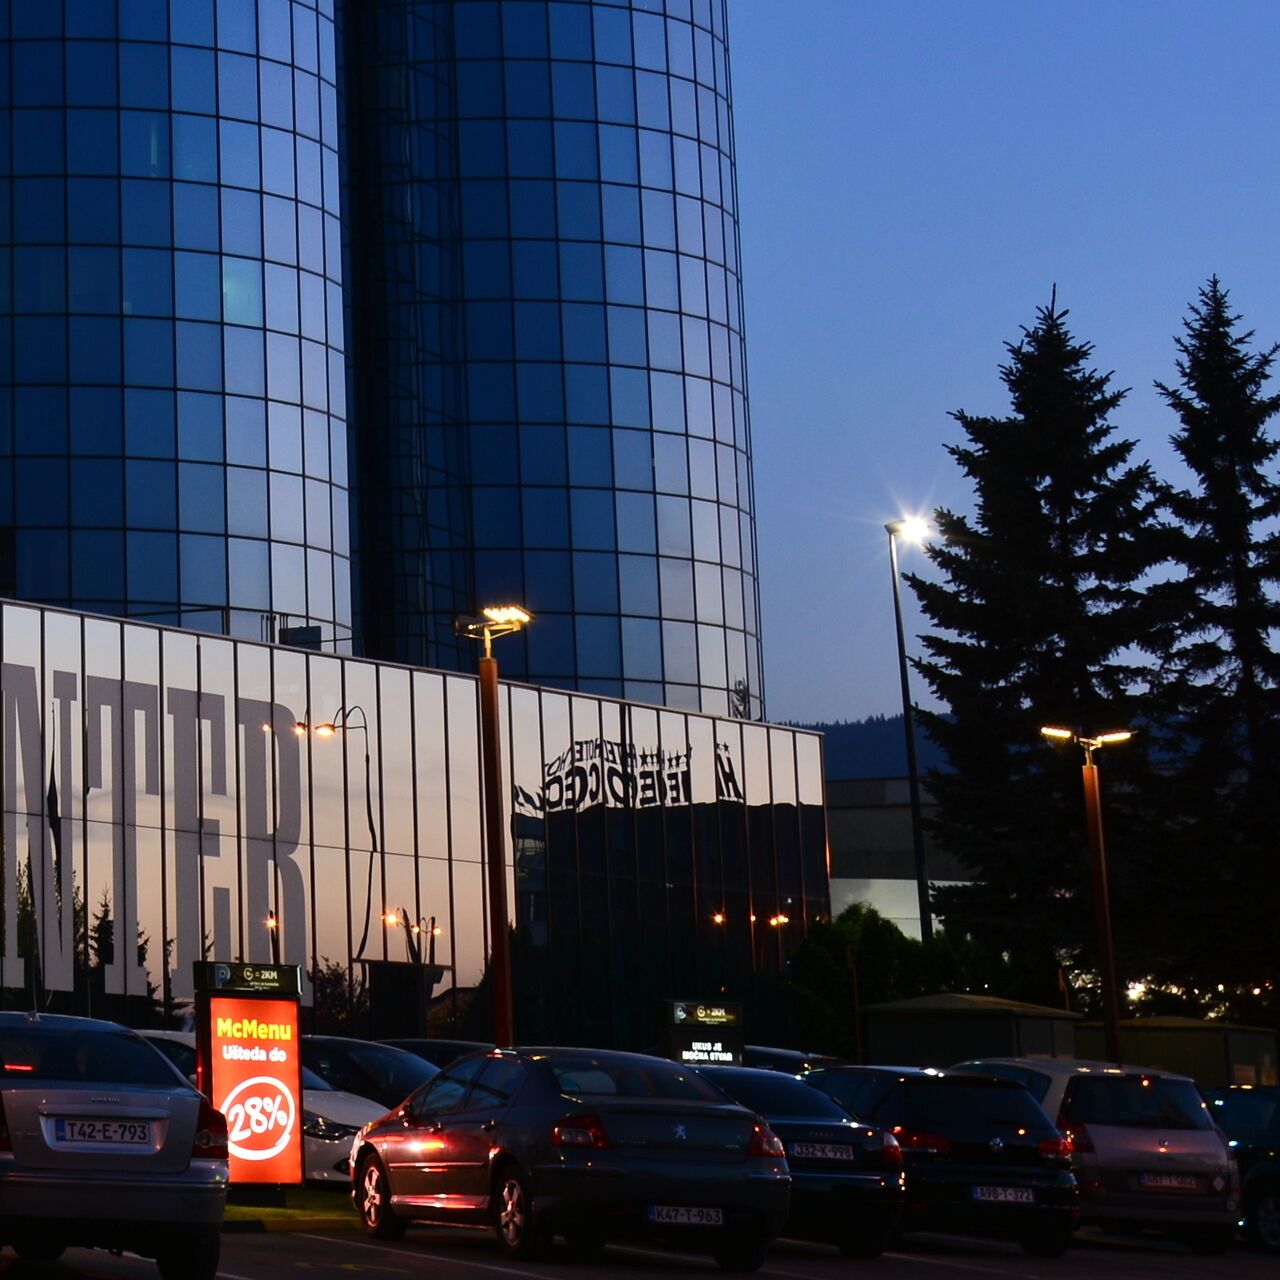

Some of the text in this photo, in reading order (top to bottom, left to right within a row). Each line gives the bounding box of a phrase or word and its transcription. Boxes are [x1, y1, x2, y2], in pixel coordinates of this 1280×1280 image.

[261, 970, 277, 980] 2KM
[217, 1018, 292, 1040] McMenu
[222, 1045, 287, 1062] Ušteda do
[227, 1094, 288, 1142] 28%
[67, 1122, 147, 1141] T42-E-793
